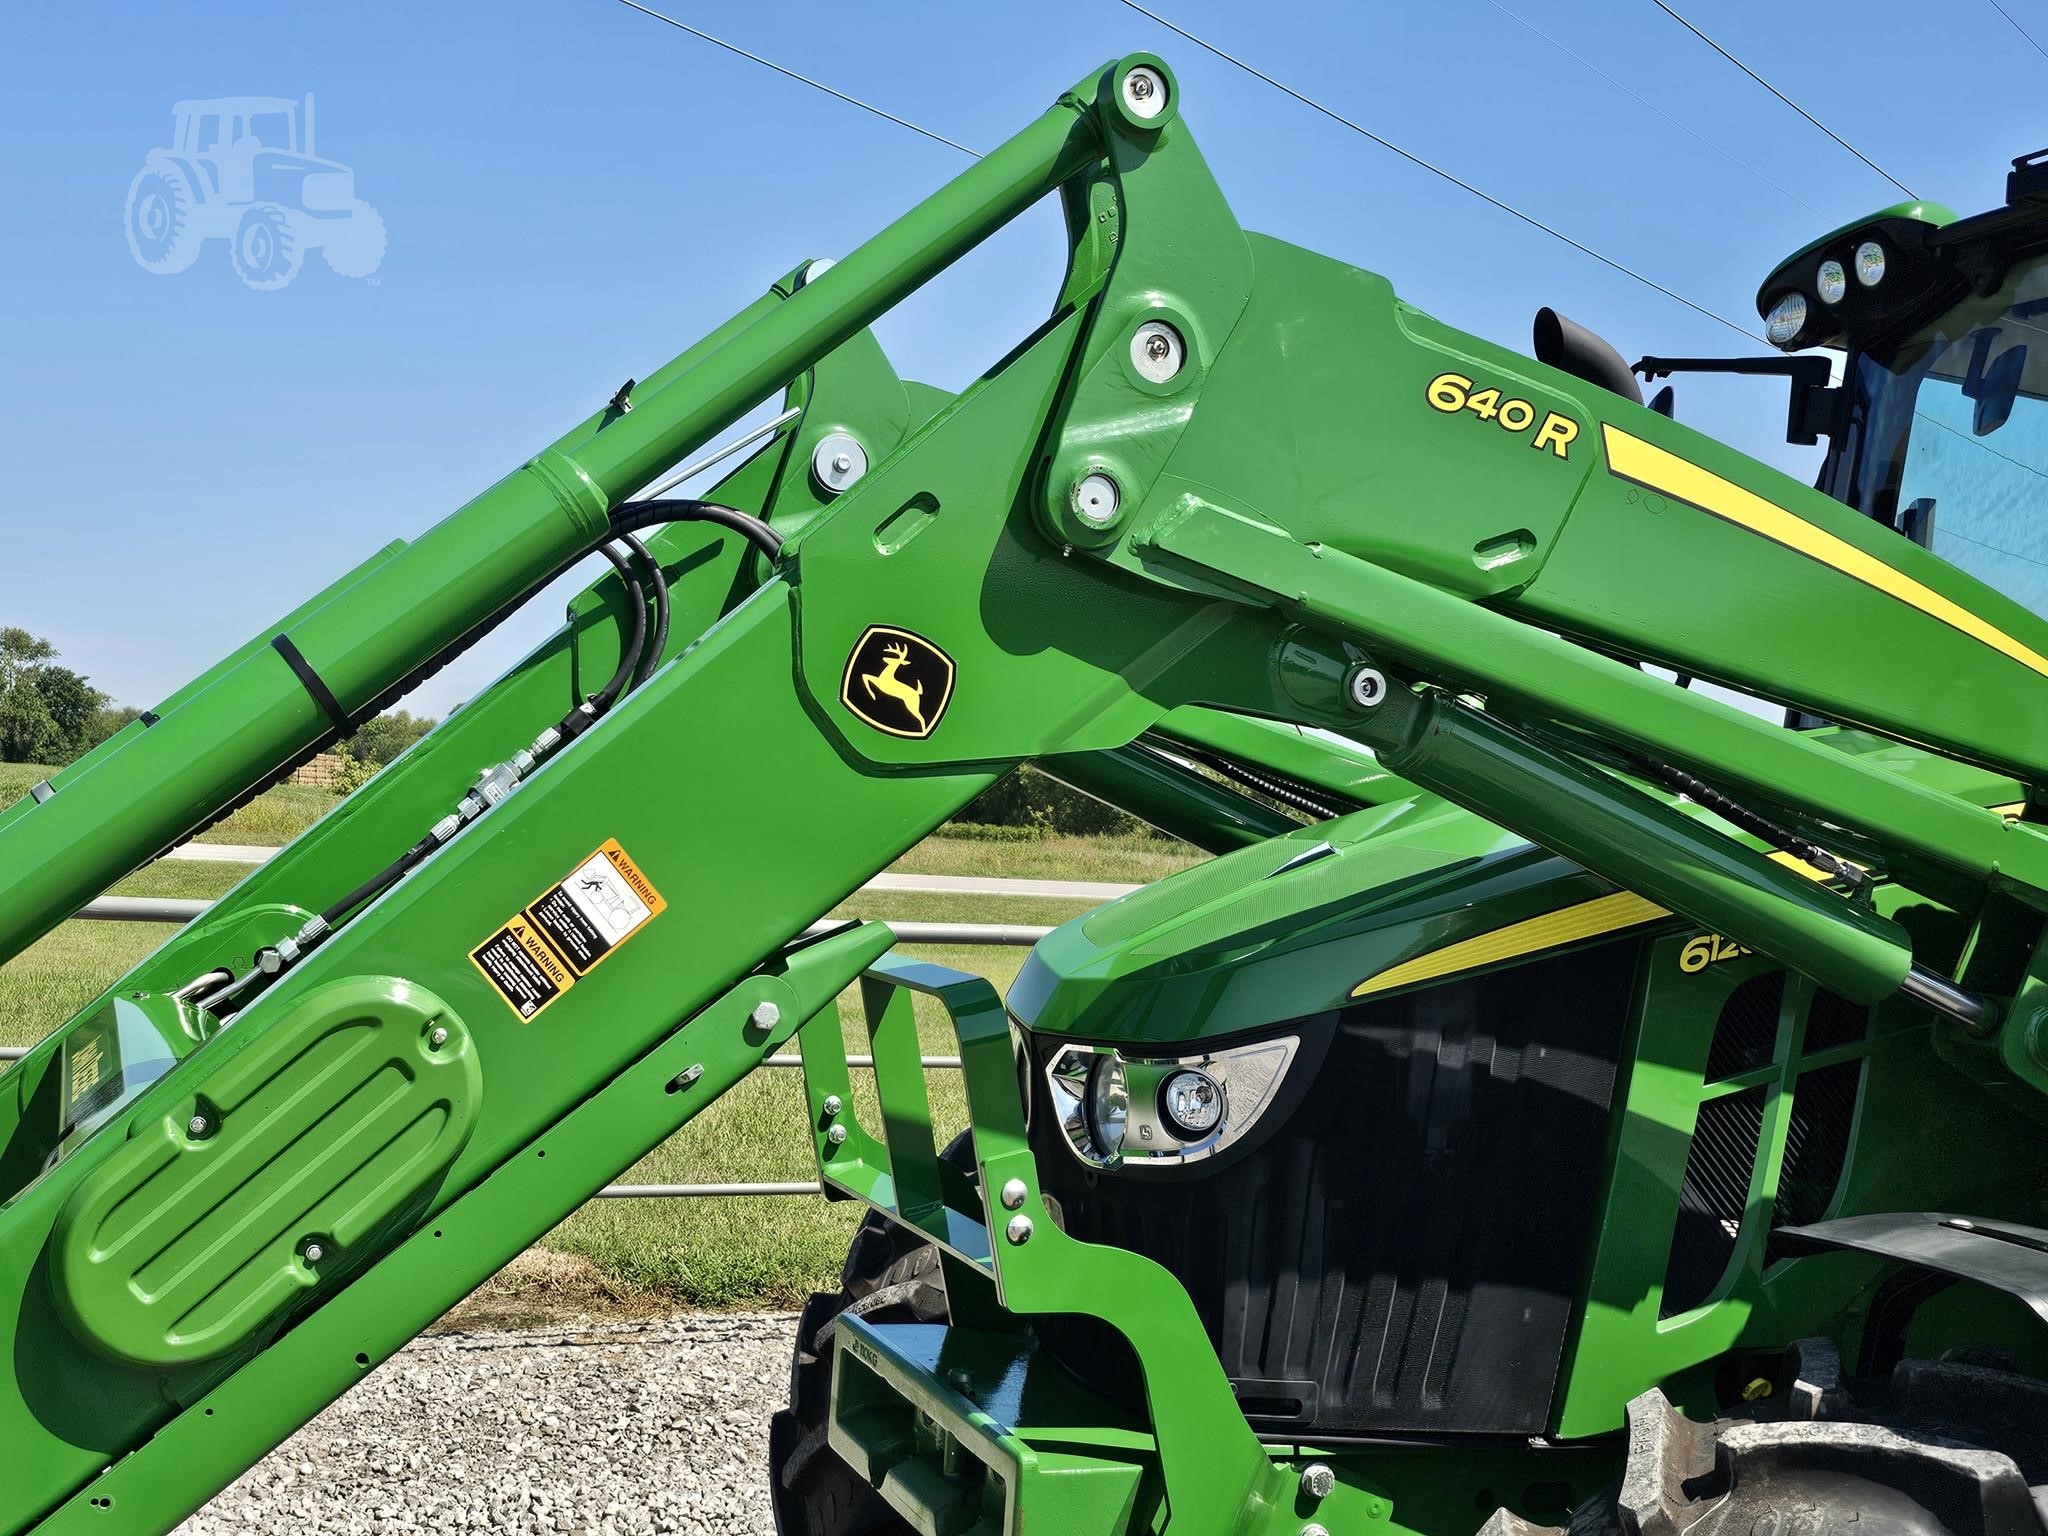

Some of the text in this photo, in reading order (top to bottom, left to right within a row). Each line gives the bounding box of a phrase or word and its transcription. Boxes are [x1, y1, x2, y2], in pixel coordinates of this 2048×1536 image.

[1425, 372, 1580, 461] 640 R
[616, 858, 658, 905] WARNING
[523, 935, 566, 983] WARNING
[1678, 932, 1753, 974] 612
